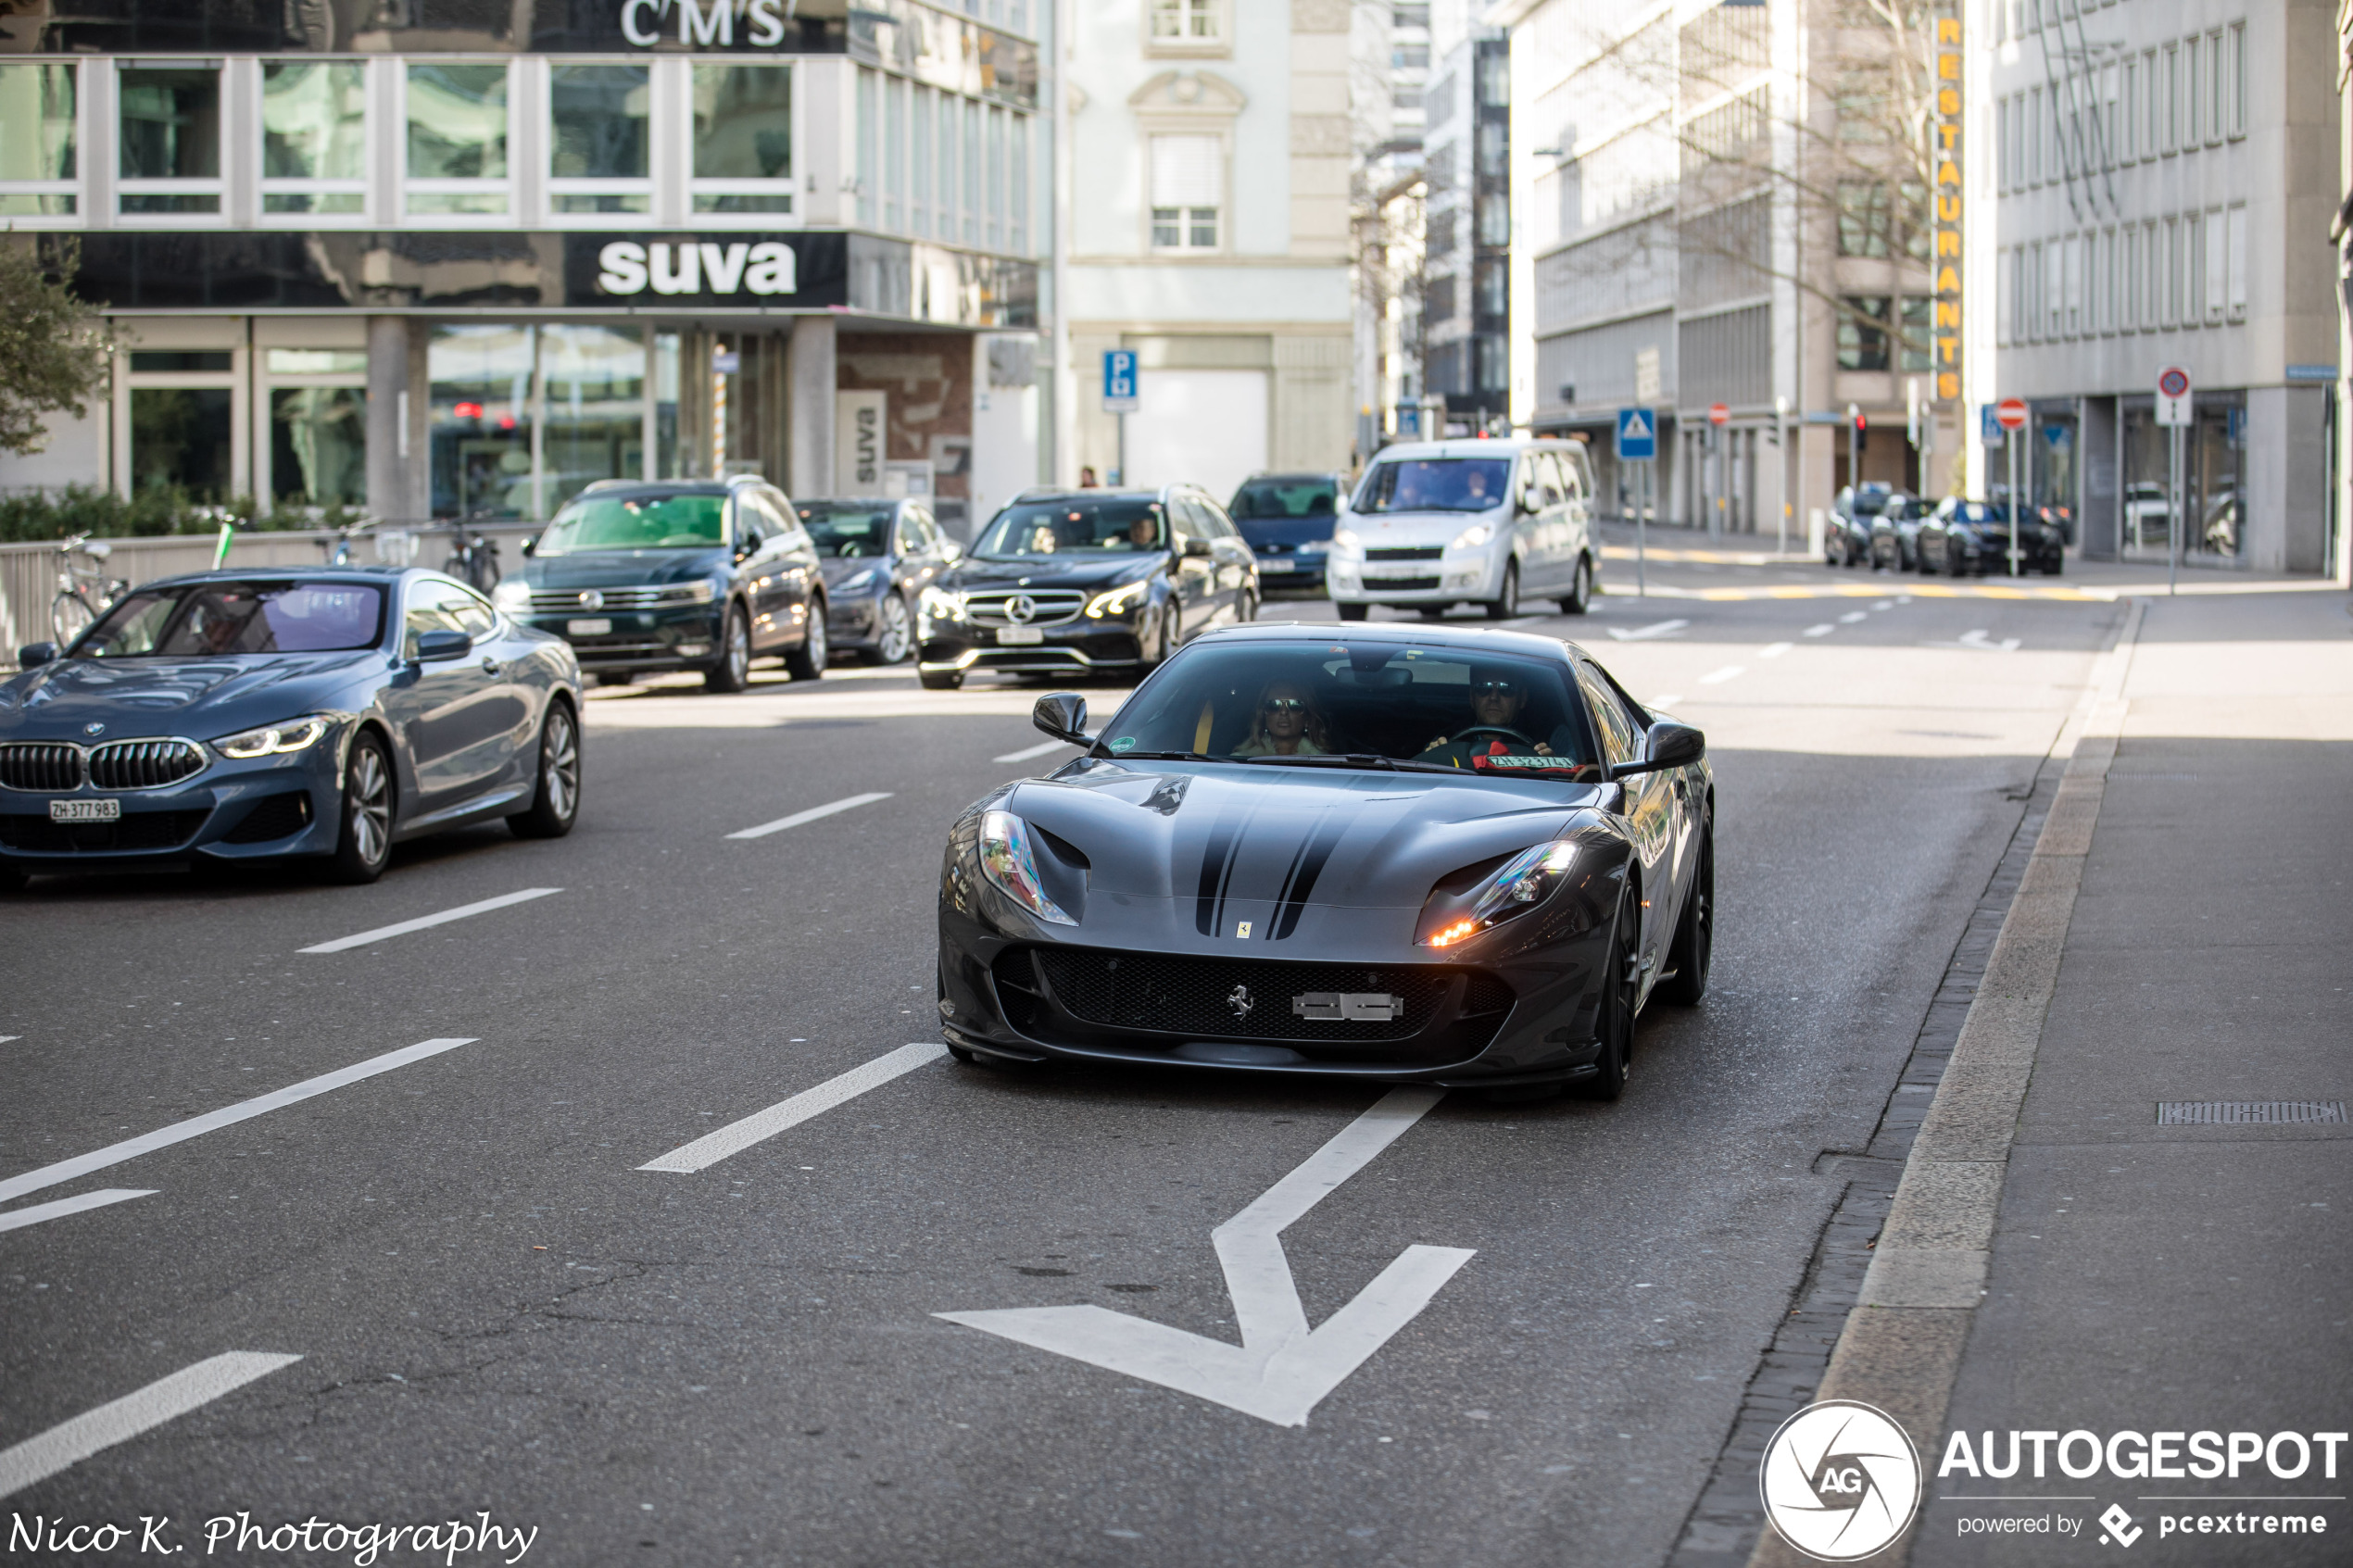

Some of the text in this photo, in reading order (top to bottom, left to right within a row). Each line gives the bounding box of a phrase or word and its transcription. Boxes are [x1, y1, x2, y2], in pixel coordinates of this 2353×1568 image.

[1937, 19, 1961, 398] RESTAURANTS
[598, 241, 798, 295] suva
[1113, 353, 1130, 378] P
[857, 406, 876, 483] suva
